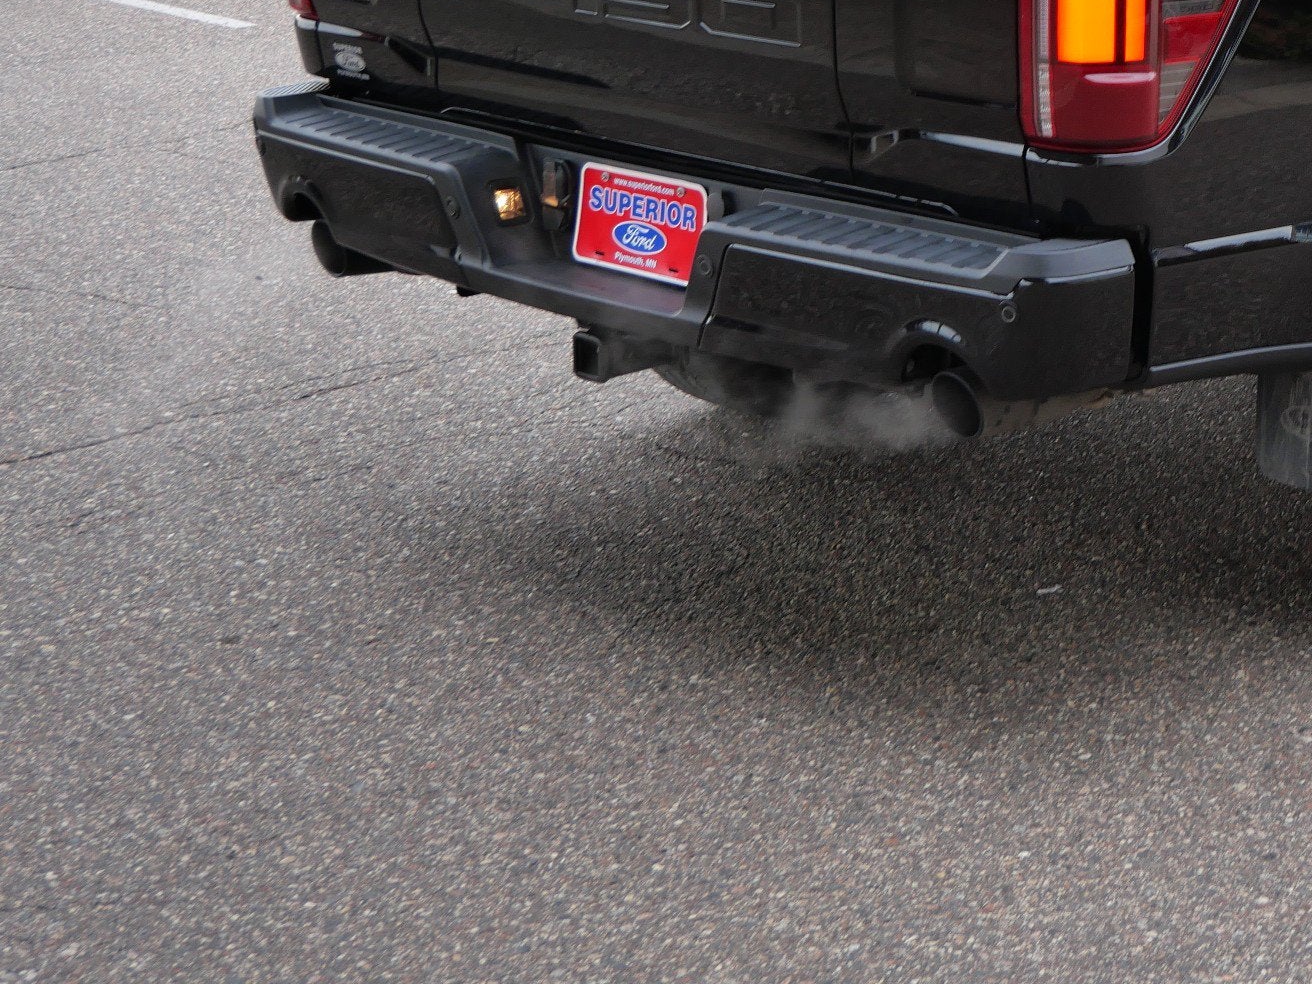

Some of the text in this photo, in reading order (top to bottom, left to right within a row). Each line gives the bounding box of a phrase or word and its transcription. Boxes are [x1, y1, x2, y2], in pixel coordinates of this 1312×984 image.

[589, 184, 697, 232] SUPERIOR
[622, 223, 657, 251] Ford
[614, 251, 658, 269] Plymouth, MN
